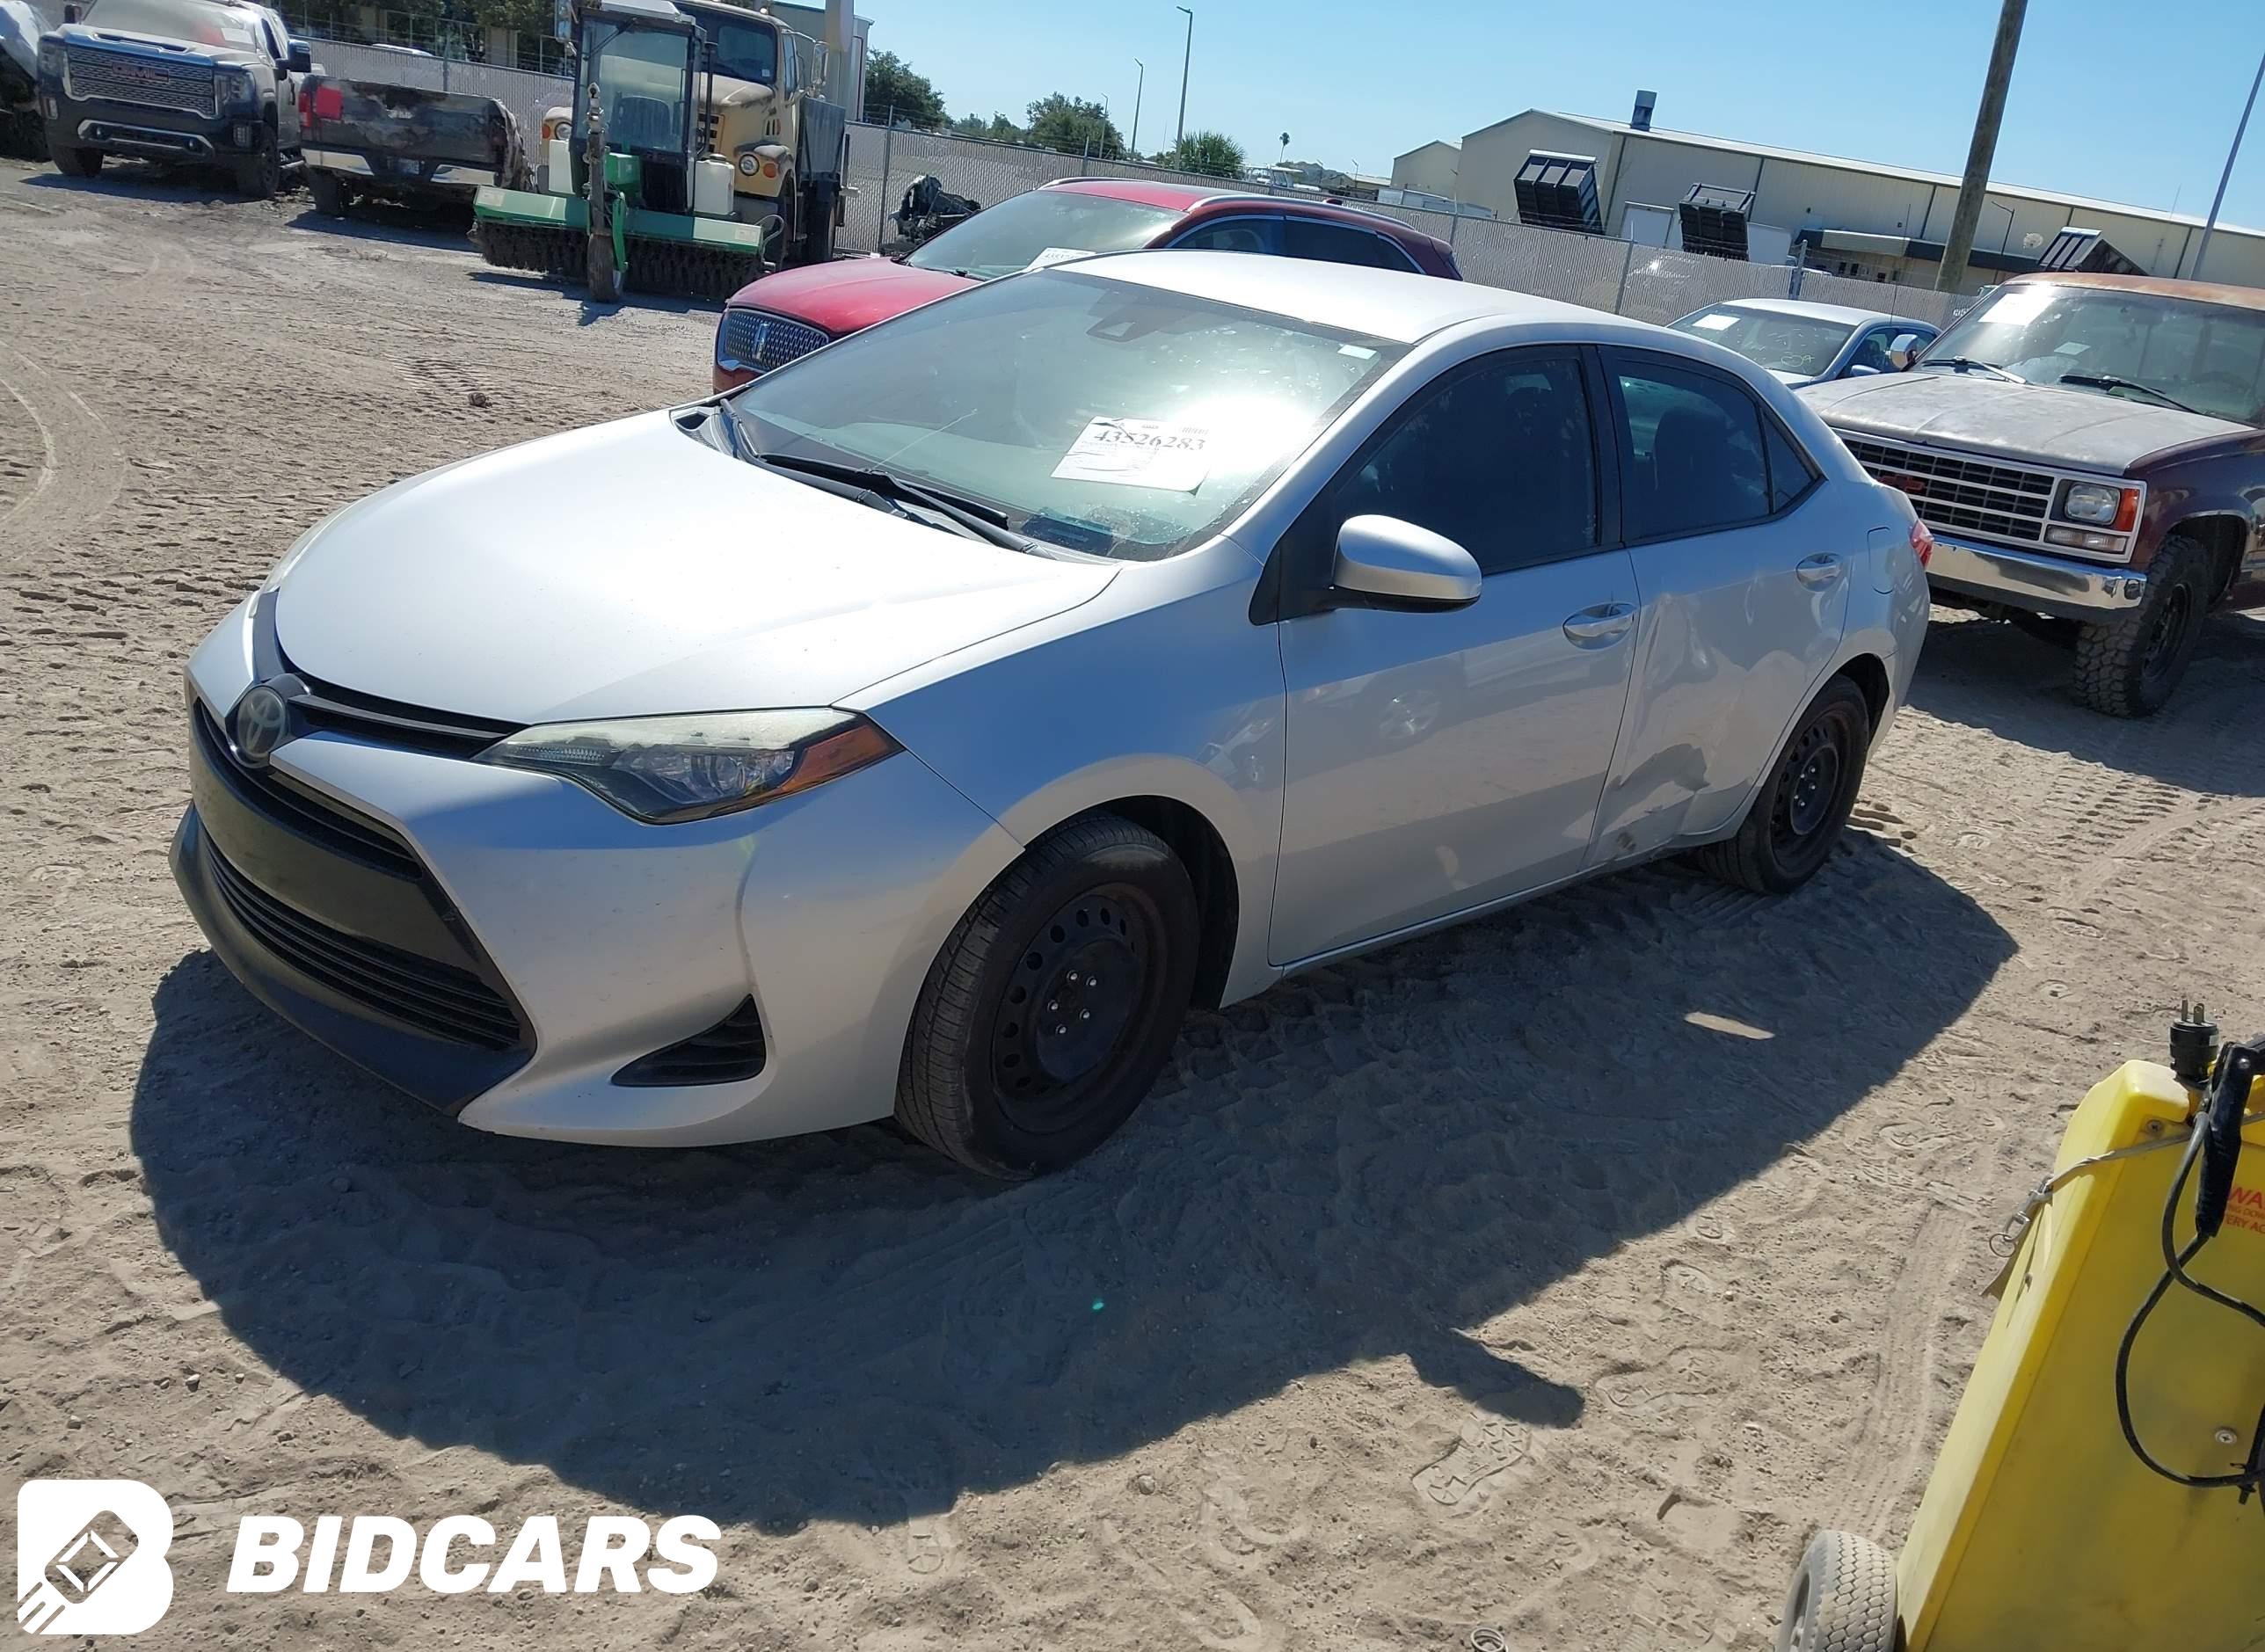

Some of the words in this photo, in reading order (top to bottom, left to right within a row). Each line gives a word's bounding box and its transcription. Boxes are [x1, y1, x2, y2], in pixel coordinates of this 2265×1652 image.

[112, 62, 170, 83] GMC
[1094, 430, 1205, 450] 43526283
[2229, 1187, 2265, 1210] WA
